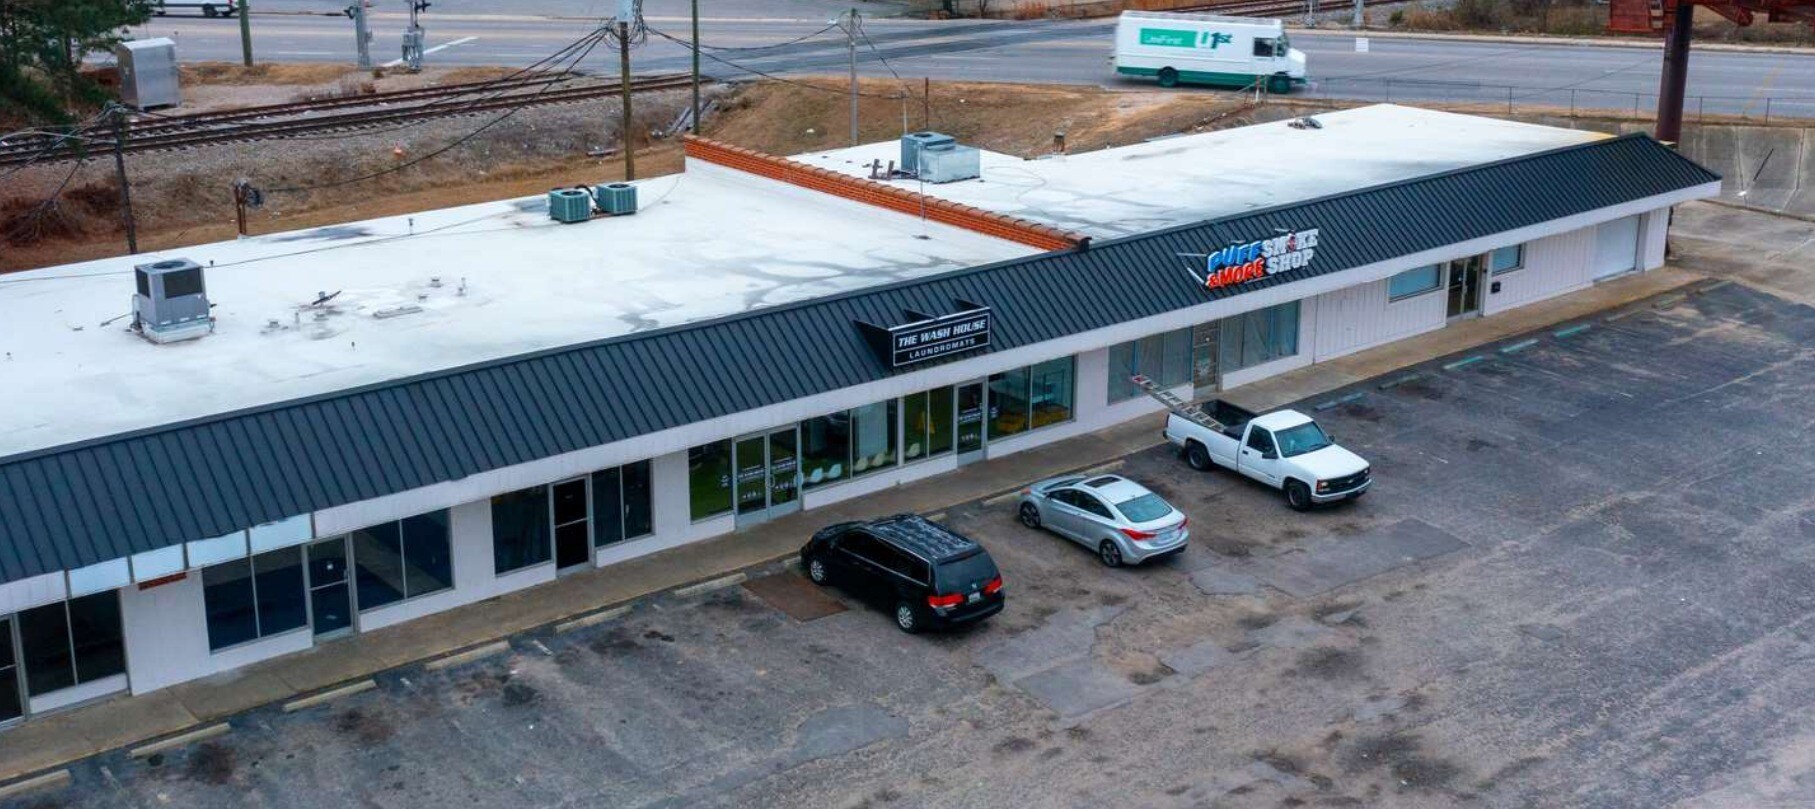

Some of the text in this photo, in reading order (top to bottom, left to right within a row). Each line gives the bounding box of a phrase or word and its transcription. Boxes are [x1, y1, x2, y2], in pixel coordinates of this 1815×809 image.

[1208, 240, 1262, 272] PUFF
[1265, 248, 1315, 275] SHOP
[898, 319, 987, 348] THE WASH HOUSE
[909, 337, 976, 359] LAUNDROMATS
